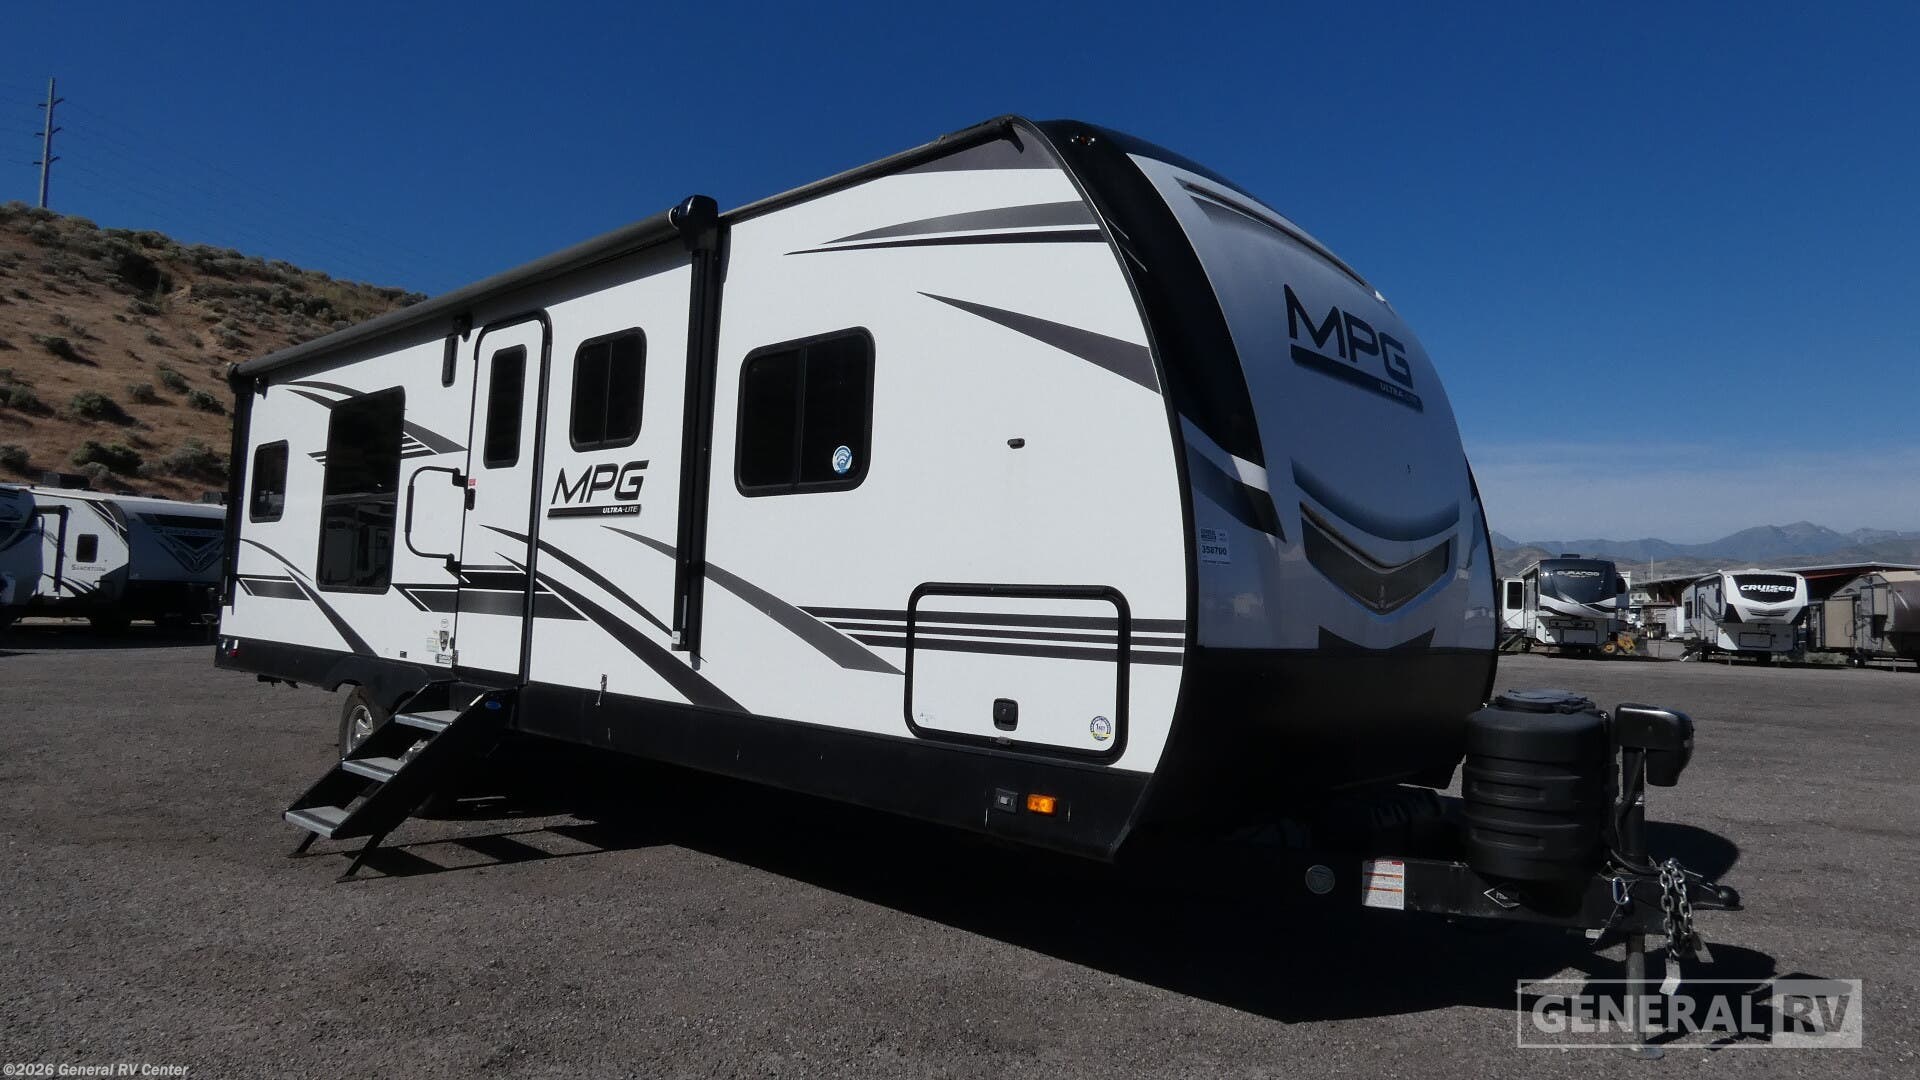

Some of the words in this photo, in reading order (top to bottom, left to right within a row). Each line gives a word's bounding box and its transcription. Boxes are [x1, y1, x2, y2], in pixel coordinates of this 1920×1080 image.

[1283, 284, 1414, 389] MPG
[551, 460, 649, 504] MPG
[602, 506, 638, 514] ULTRA-LITE
[1740, 584, 1795, 592] CRUISER
